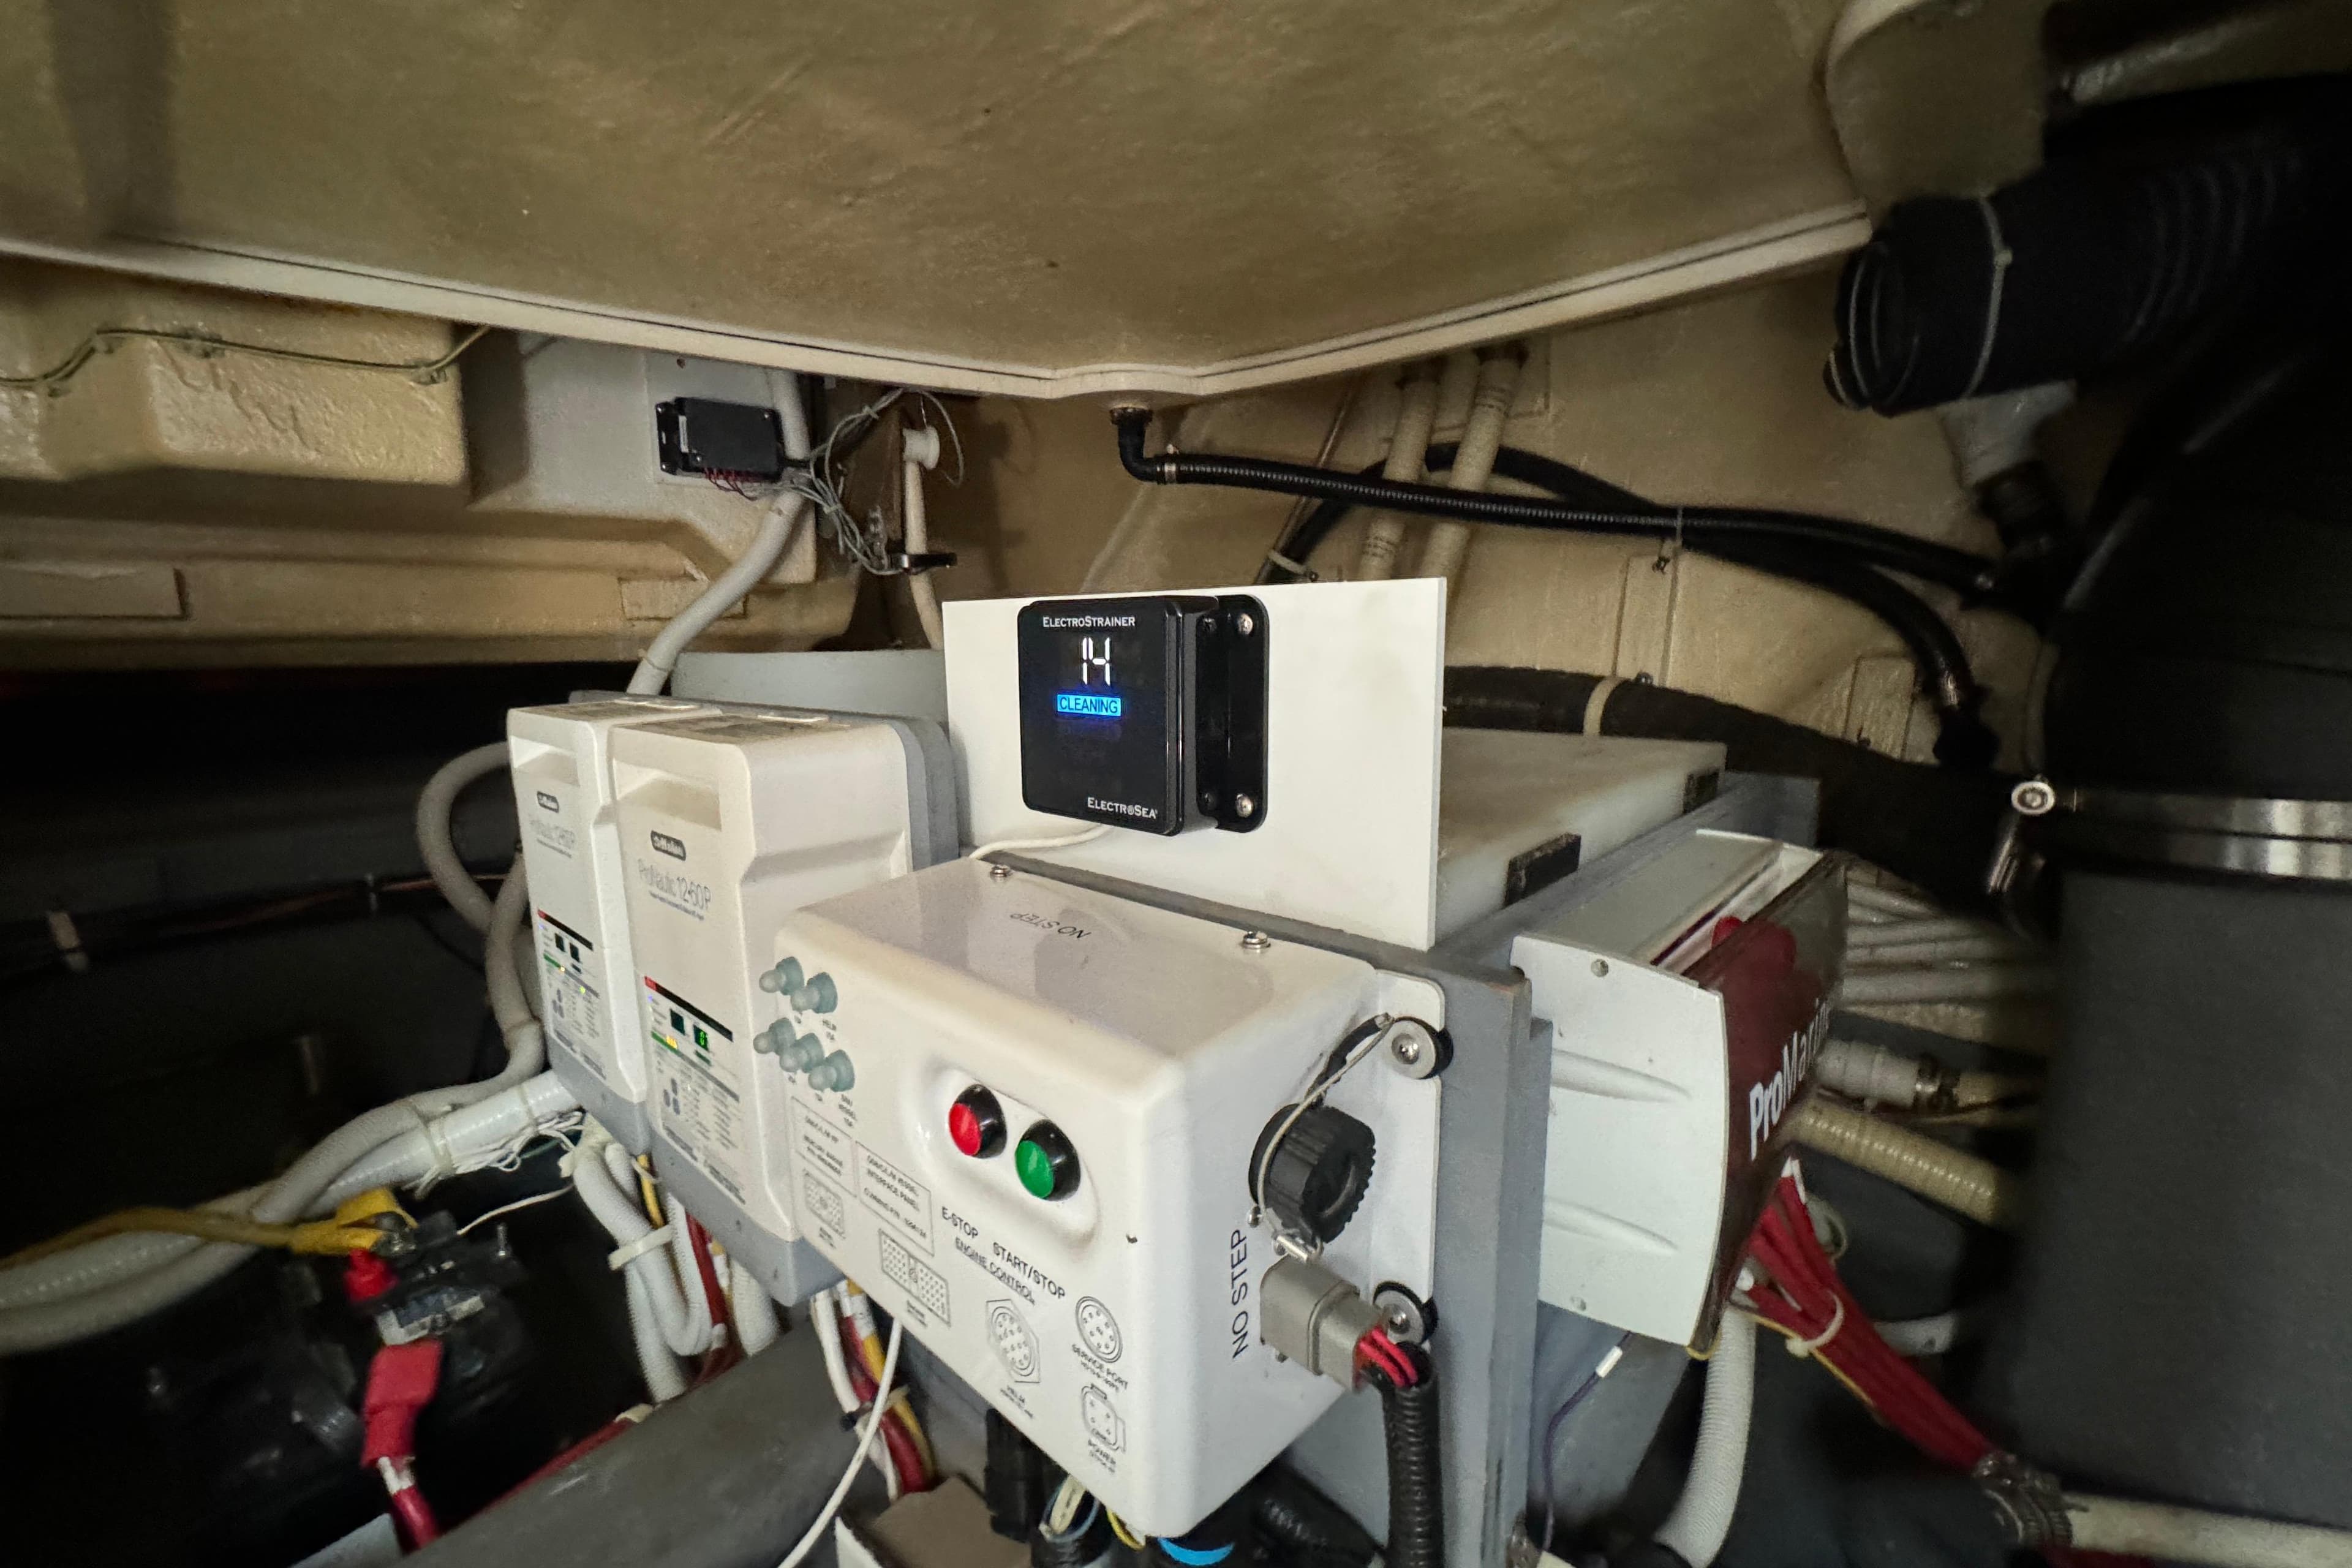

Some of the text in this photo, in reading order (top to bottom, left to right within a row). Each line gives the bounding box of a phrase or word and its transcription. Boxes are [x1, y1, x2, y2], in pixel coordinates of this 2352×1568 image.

[1082, 637, 1111, 686] 14
[1060, 697, 1118, 714] CLEANING
[1010, 912, 1091, 939] NO STEP
[942, 1206, 979, 1238] E-STOP
[993, 1242, 1066, 1299] START/STOP
[1231, 1229, 1249, 1359] NO STEP
